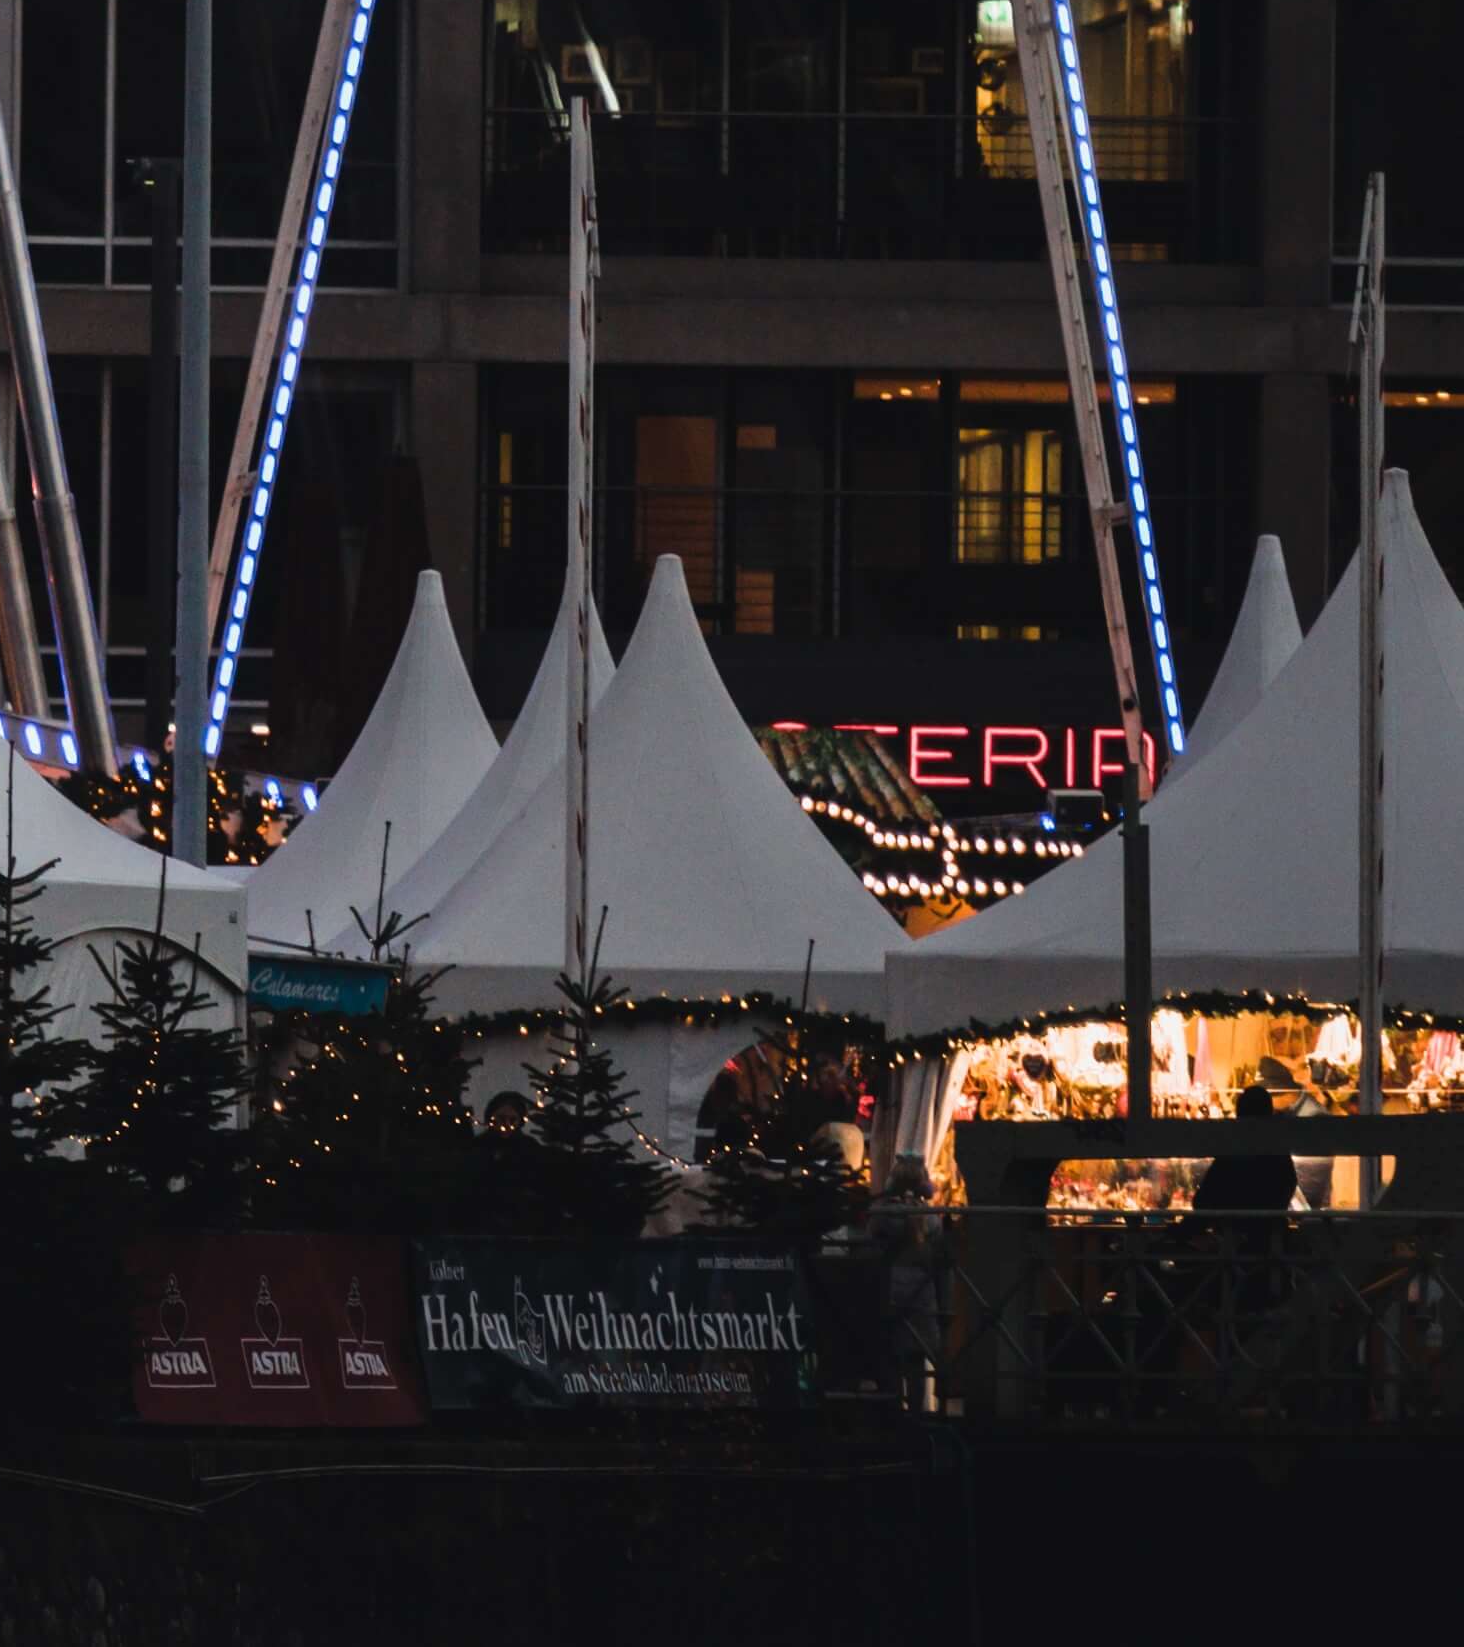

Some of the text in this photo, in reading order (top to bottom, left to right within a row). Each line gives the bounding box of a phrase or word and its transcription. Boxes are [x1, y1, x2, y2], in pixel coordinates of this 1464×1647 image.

[250, 967, 340, 1002] Calamares
[422, 1290, 807, 1352] Hafen Weihnachtsmarkt
[151, 1351, 208, 1376] ASTRA
[251, 1351, 301, 1377] ASTRA
[345, 1352, 389, 1377] ASTRA
